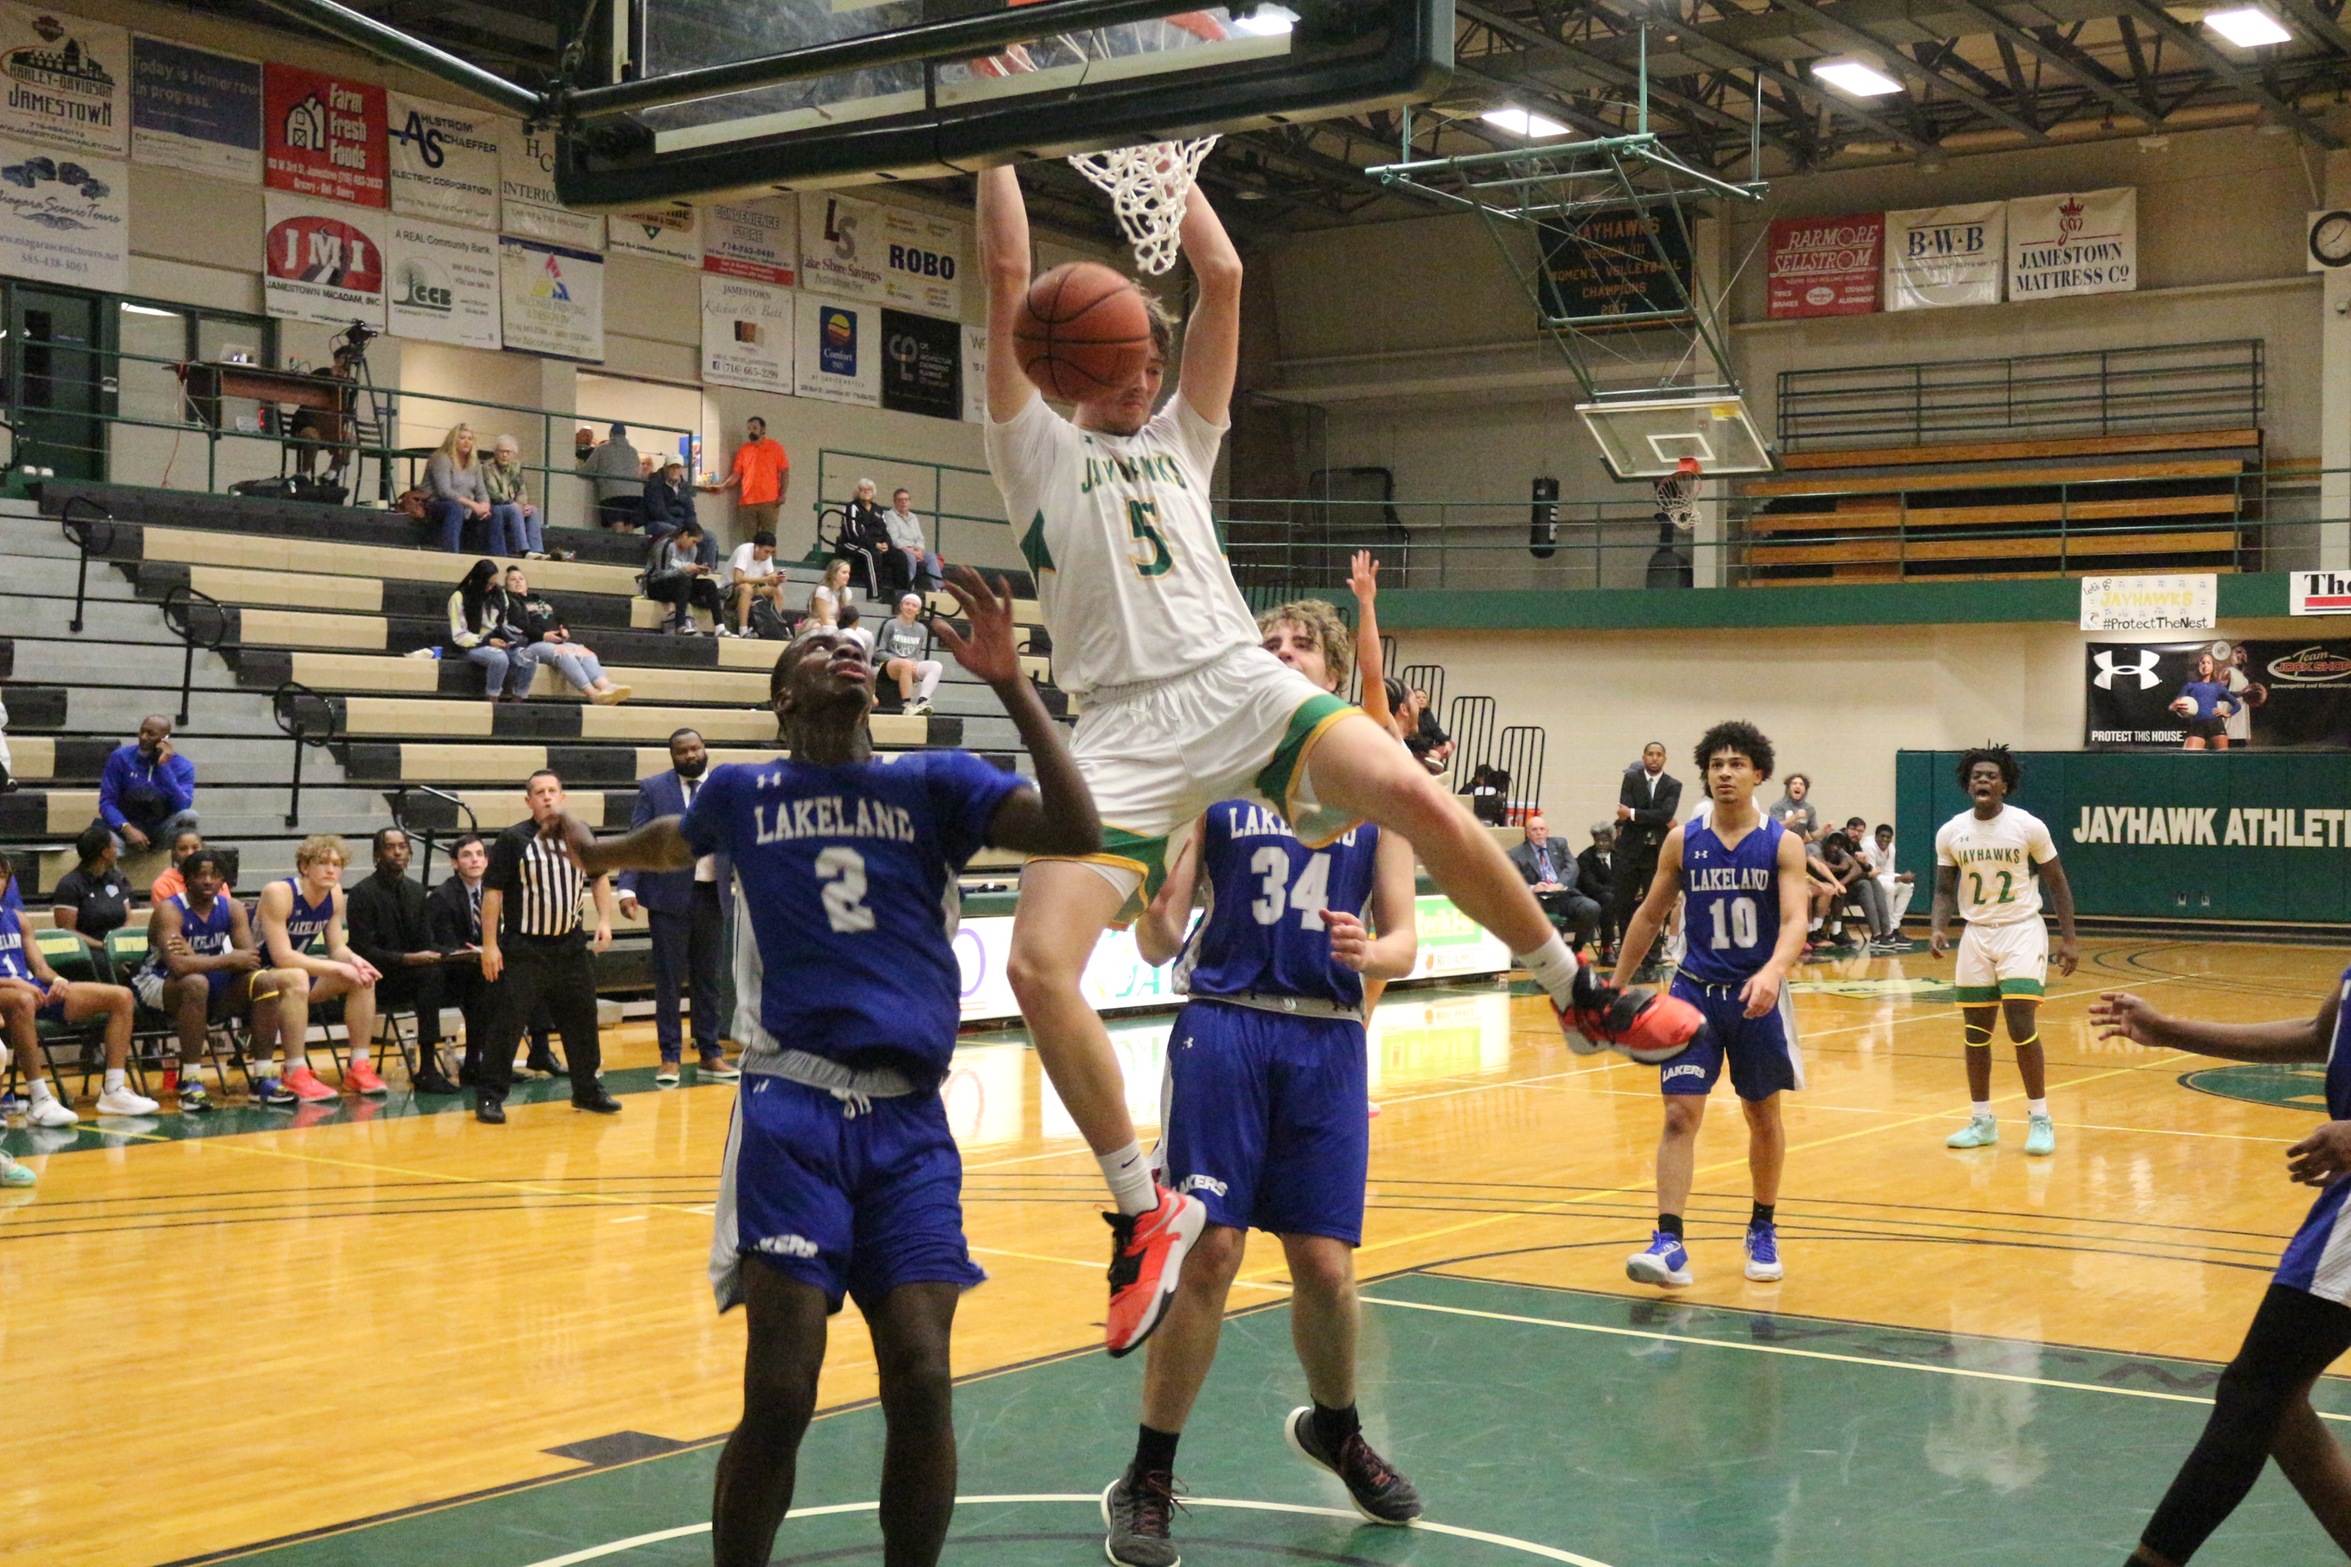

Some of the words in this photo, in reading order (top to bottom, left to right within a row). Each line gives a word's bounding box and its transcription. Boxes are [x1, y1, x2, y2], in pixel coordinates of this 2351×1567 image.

[9, 63, 113, 99] HARLEY-DAVIDSON
[8, 83, 112, 127] JAMESTOWN
[329, 82, 363, 114] Farm
[329, 111, 367, 142] Fresh
[329, 138, 367, 171] Foods
[391, 169, 432, 185] ELECTRIC
[433, 177, 493, 197] CORPORATION
[44, 196, 86, 218] Scenic
[86, 203, 122, 224] Tours
[715, 205, 780, 230] CONVENIENCE
[396, 229, 402, 239] A
[403, 230, 426, 244] REAL
[426, 235, 470, 253] Community
[732, 226, 764, 243] STORE
[666, 249, 687, 261] Bowling
[889, 243, 955, 280] ROBO
[1773, 248, 1874, 275] SELLSTROM
[2018, 241, 2123, 270] JAMESTOWN
[822, 257, 849, 276] Shore
[848, 263, 882, 284] Savings
[2016, 266, 2104, 293] MATTRESS
[266, 280, 320, 297] JAMESTOWN
[722, 284, 772, 300] JAMESTOWN
[1582, 282, 1648, 299] CHAMPIONS
[1772, 300, 1799, 309] BRAKES
[823, 347, 853, 362] Comfort
[1123, 495, 1178, 583] 5
[2082, 582, 2101, 596] Let's
[2100, 591, 2194, 608] JAYHAWKS
[2102, 616, 2209, 631] #ProtectTheNest
[2274, 661, 2314, 673] JOCK
[2305, 682, 2318, 690] and
[2091, 730, 2133, 742] PROTECT
[2134, 730, 2151, 742] THIS
[754, 796, 916, 846] LAKELAND
[2072, 806, 2218, 846] JAYHAWK
[814, 846, 877, 933] 2
[1251, 845, 1332, 932] 34
[1689, 867, 1769, 892] LAKELAND
[1968, 870, 2016, 905] 22
[1708, 896, 1759, 950] 10
[1662, 1064, 1707, 1083] LAKERS
